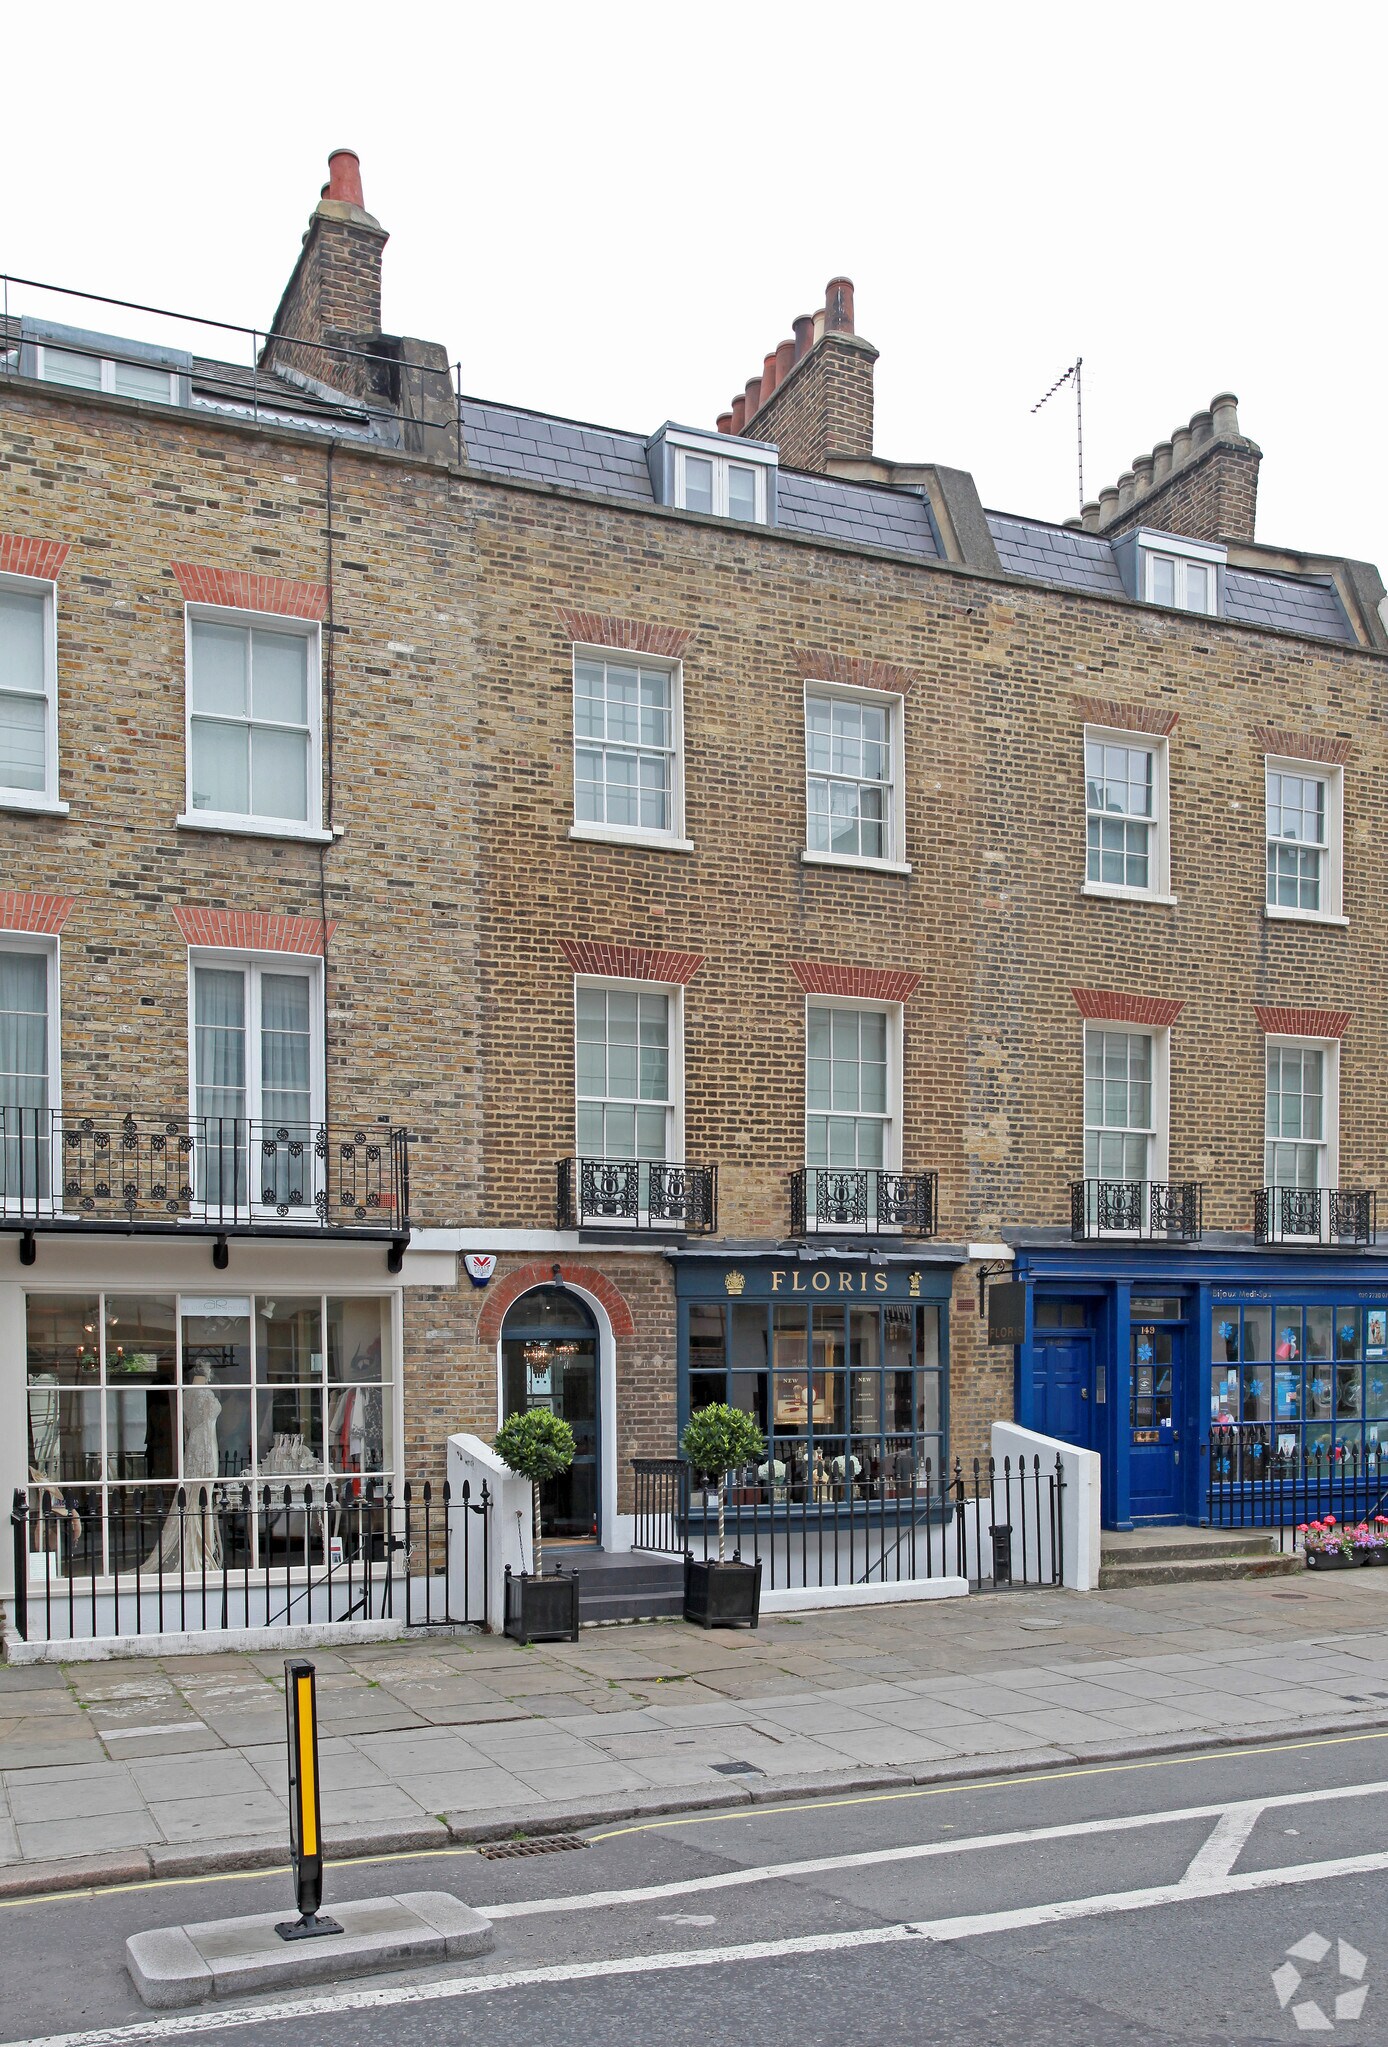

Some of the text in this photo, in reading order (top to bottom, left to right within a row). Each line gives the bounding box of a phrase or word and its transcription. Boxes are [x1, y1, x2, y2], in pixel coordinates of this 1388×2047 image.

[771, 1271, 888, 1291] FLORIS
[1212, 1289, 1236, 1299] Bijoux
[989, 1326, 1024, 1339] FLORIS
[1140, 1326, 1155, 1335] 149
